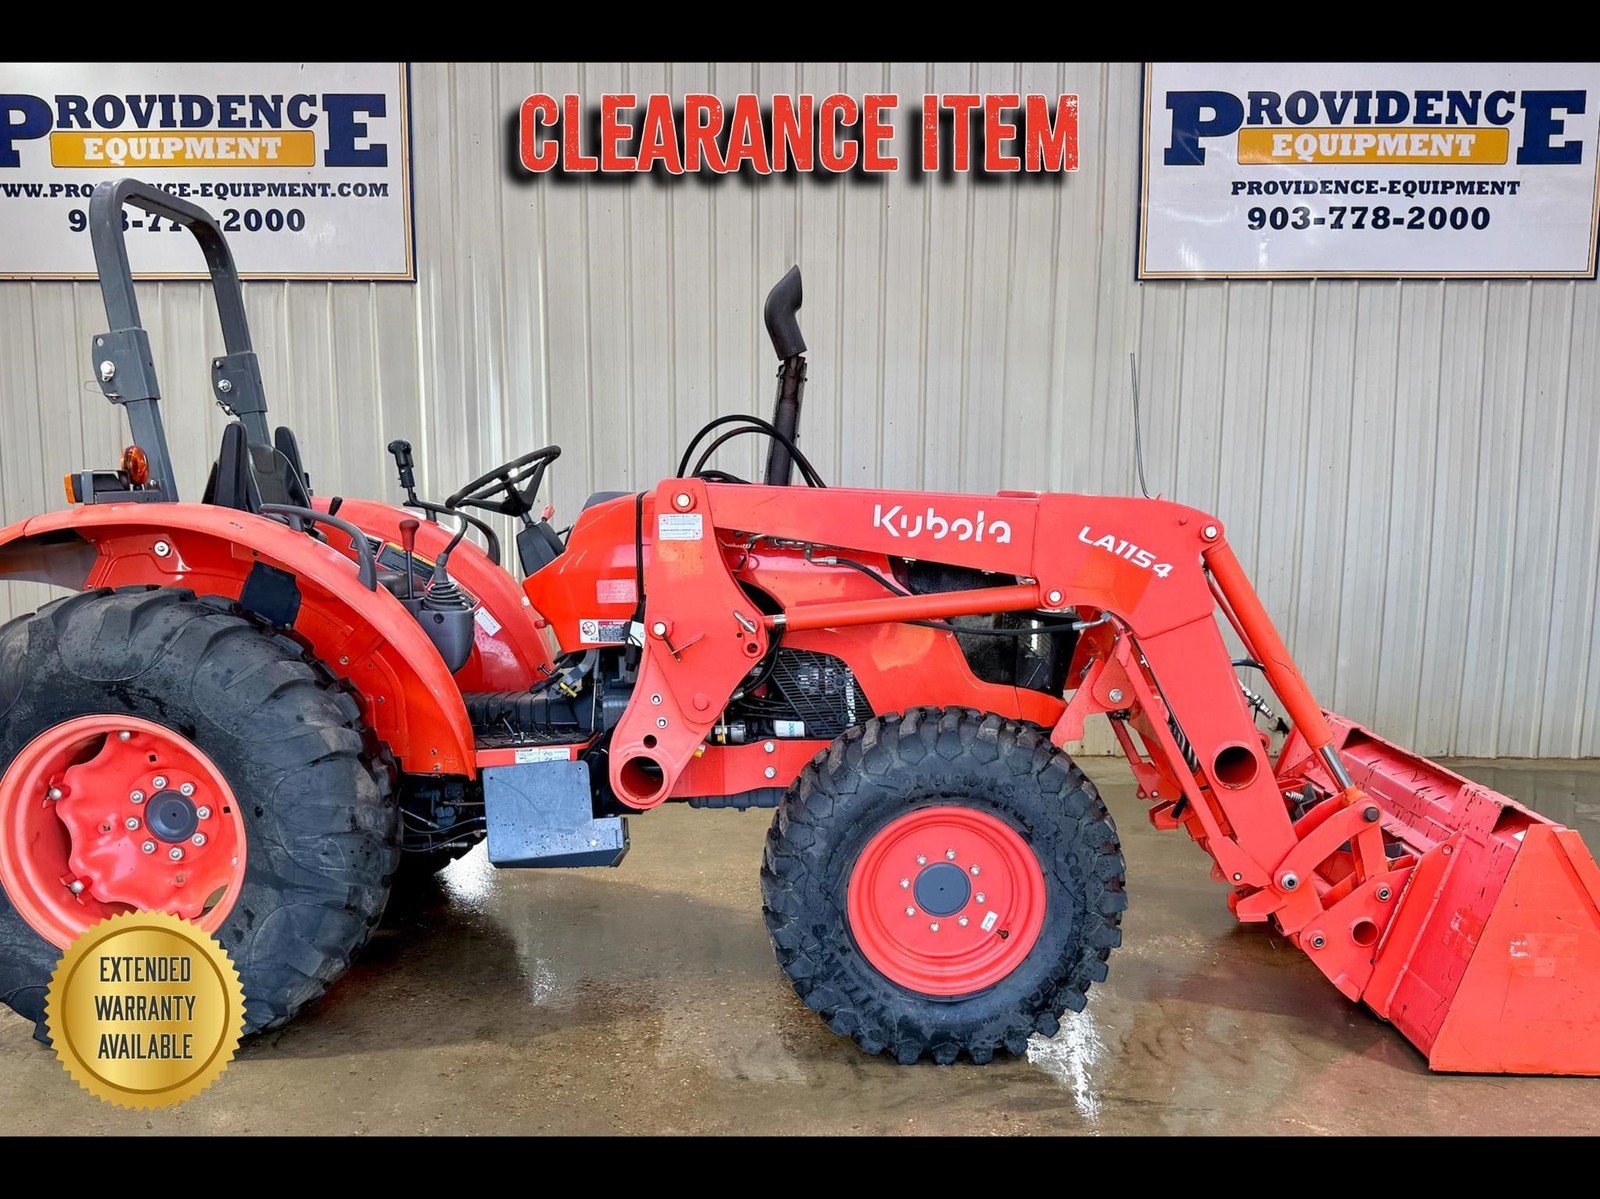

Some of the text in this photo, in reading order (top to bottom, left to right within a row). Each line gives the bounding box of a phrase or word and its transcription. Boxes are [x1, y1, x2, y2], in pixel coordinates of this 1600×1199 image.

[0, 93, 388, 167] PROVIDENCE
[1163, 89, 1588, 166] PROVIDENCE
[83, 136, 282, 166] EQUIPMENT
[1271, 132, 1476, 162] EQUIPMENT
[0, 183, 389, 201] WW.PROCE-EQUIPMENT.COM
[1231, 179, 1521, 199] PROVIDENCE-EQUIPMENT
[67, 208, 306, 233] 9-72000
[1246, 206, 1492, 231] 903-778-2000
[872, 503, 1012, 544] Kubota
[1077, 525, 1175, 578] LA1154
